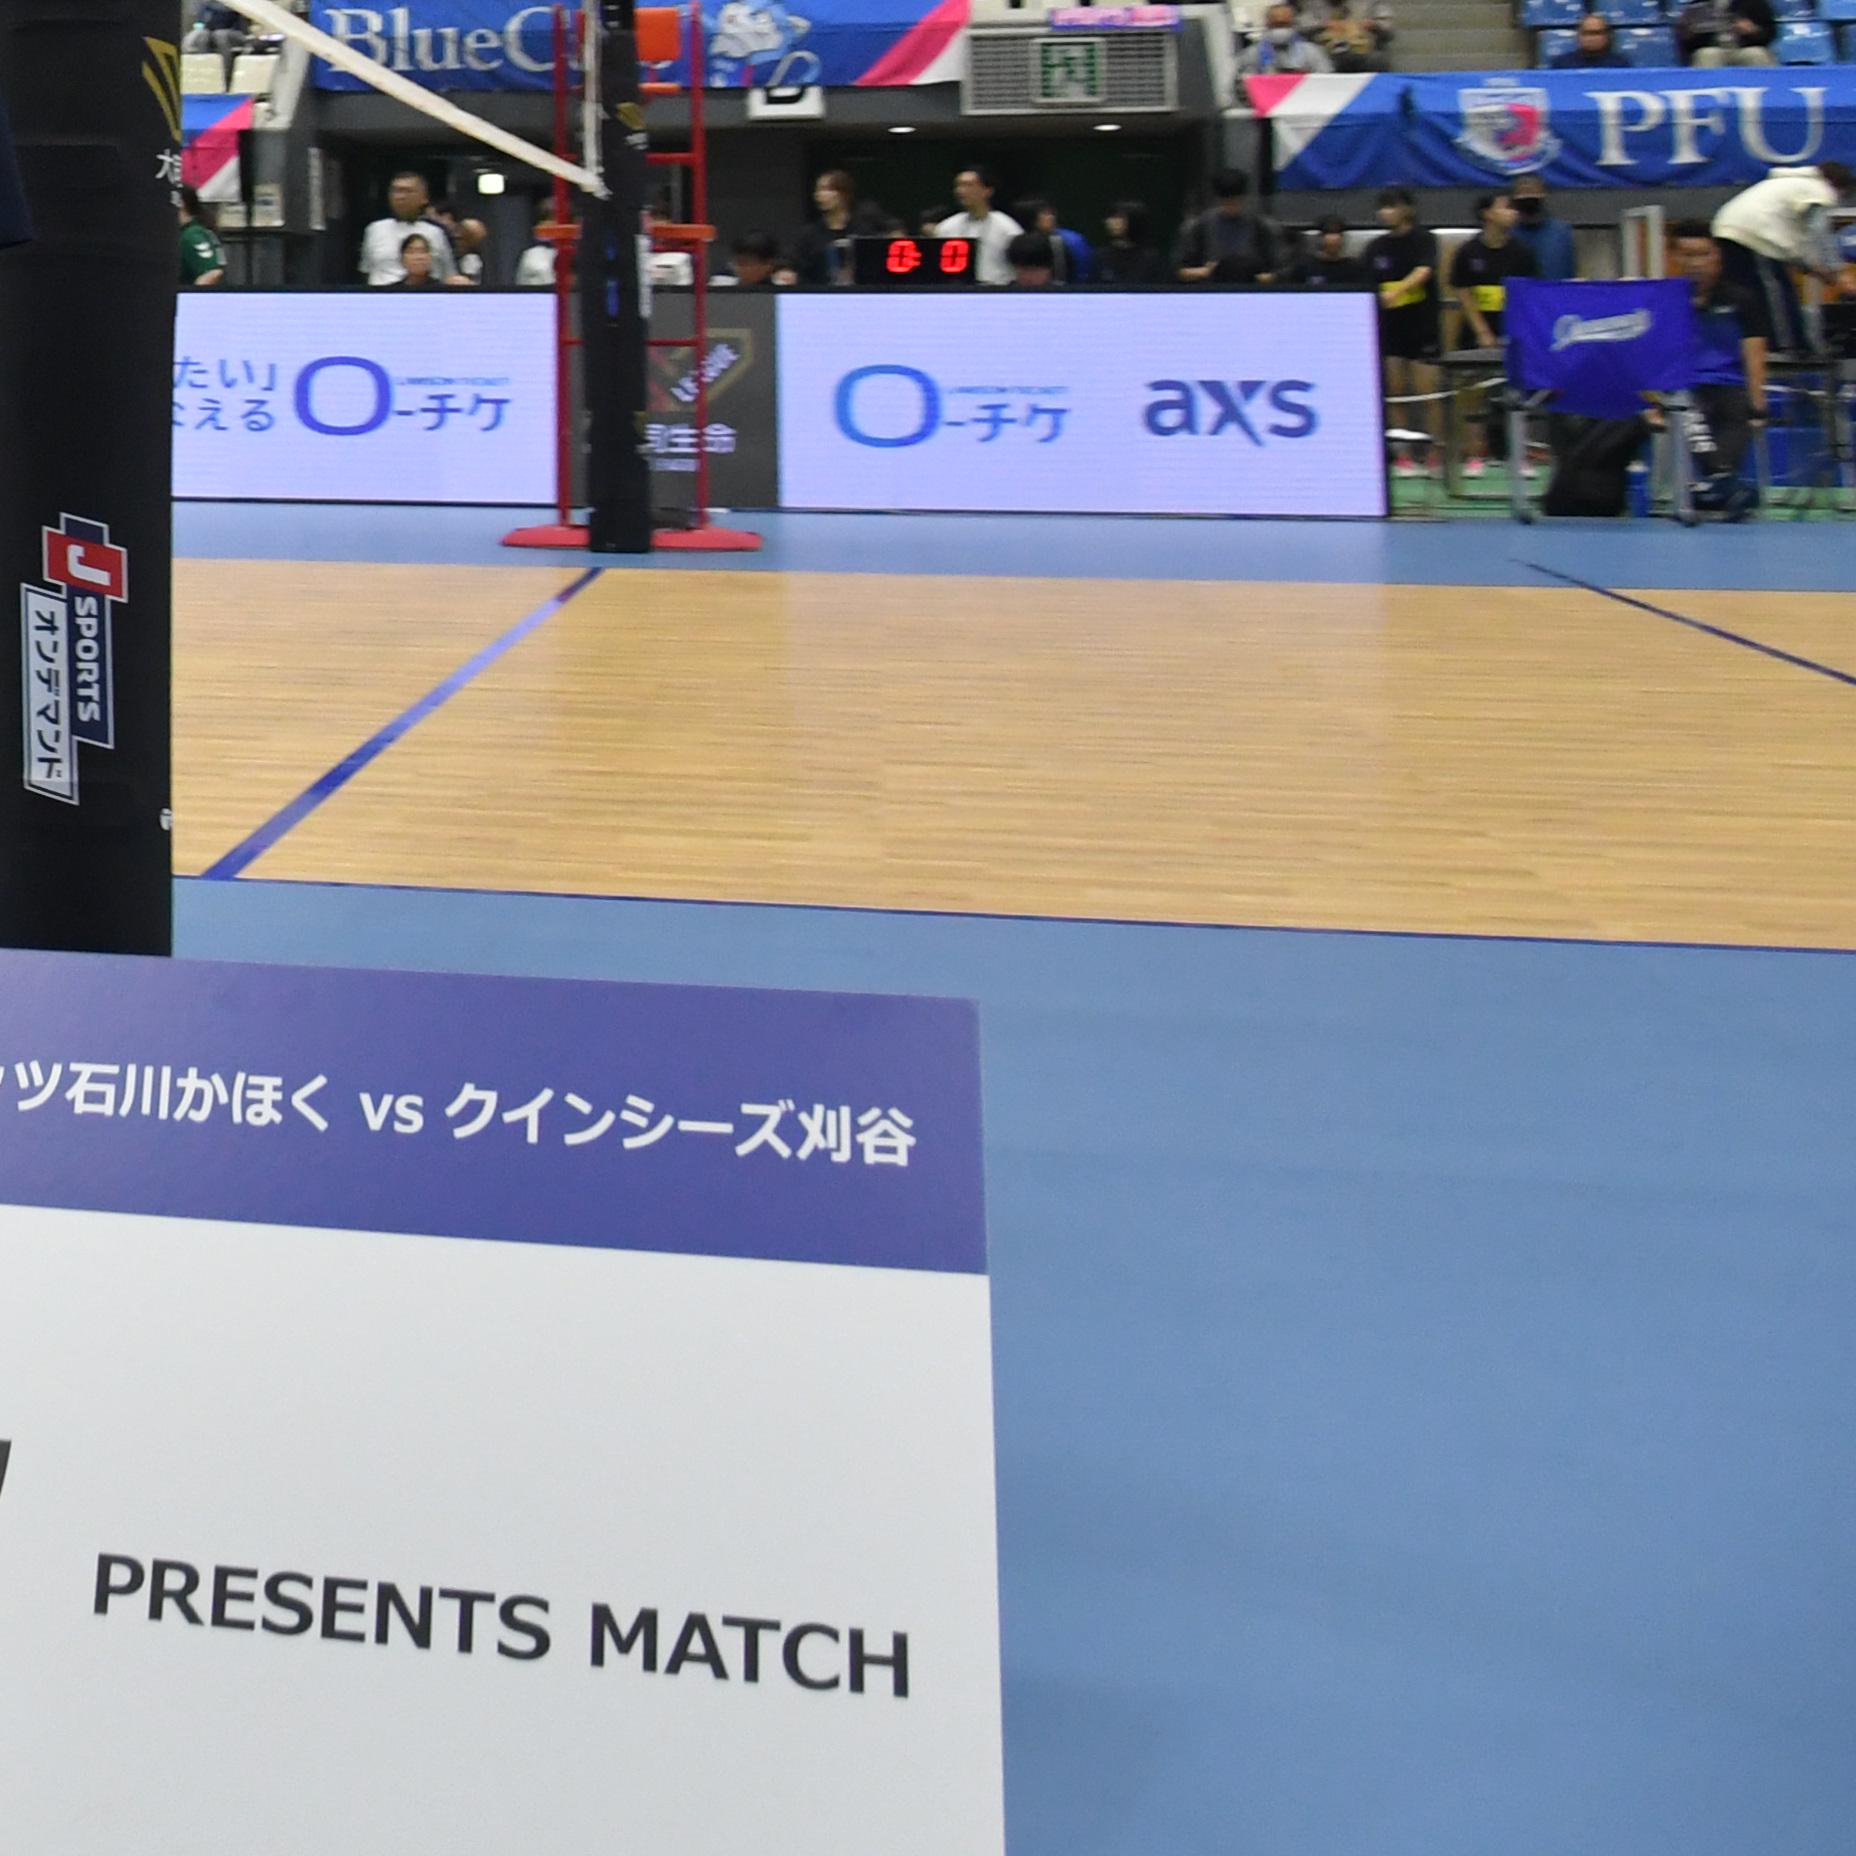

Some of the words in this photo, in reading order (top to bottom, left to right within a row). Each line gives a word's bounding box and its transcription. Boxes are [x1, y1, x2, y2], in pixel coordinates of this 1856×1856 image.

[322, 5, 588, 73] BlueC
[1582, 86, 1829, 167] PFU
[1143, 378, 1319, 447] axs
[66, 543, 112, 587] J
[33, 608, 63, 779] オンデマンド
[74, 595, 101, 724] SPORTS
[447, 1081, 918, 1169] クインシーズ刈谷
[93, 1552, 553, 1661] PRESENTS
[589, 1602, 912, 1700] MATCH
